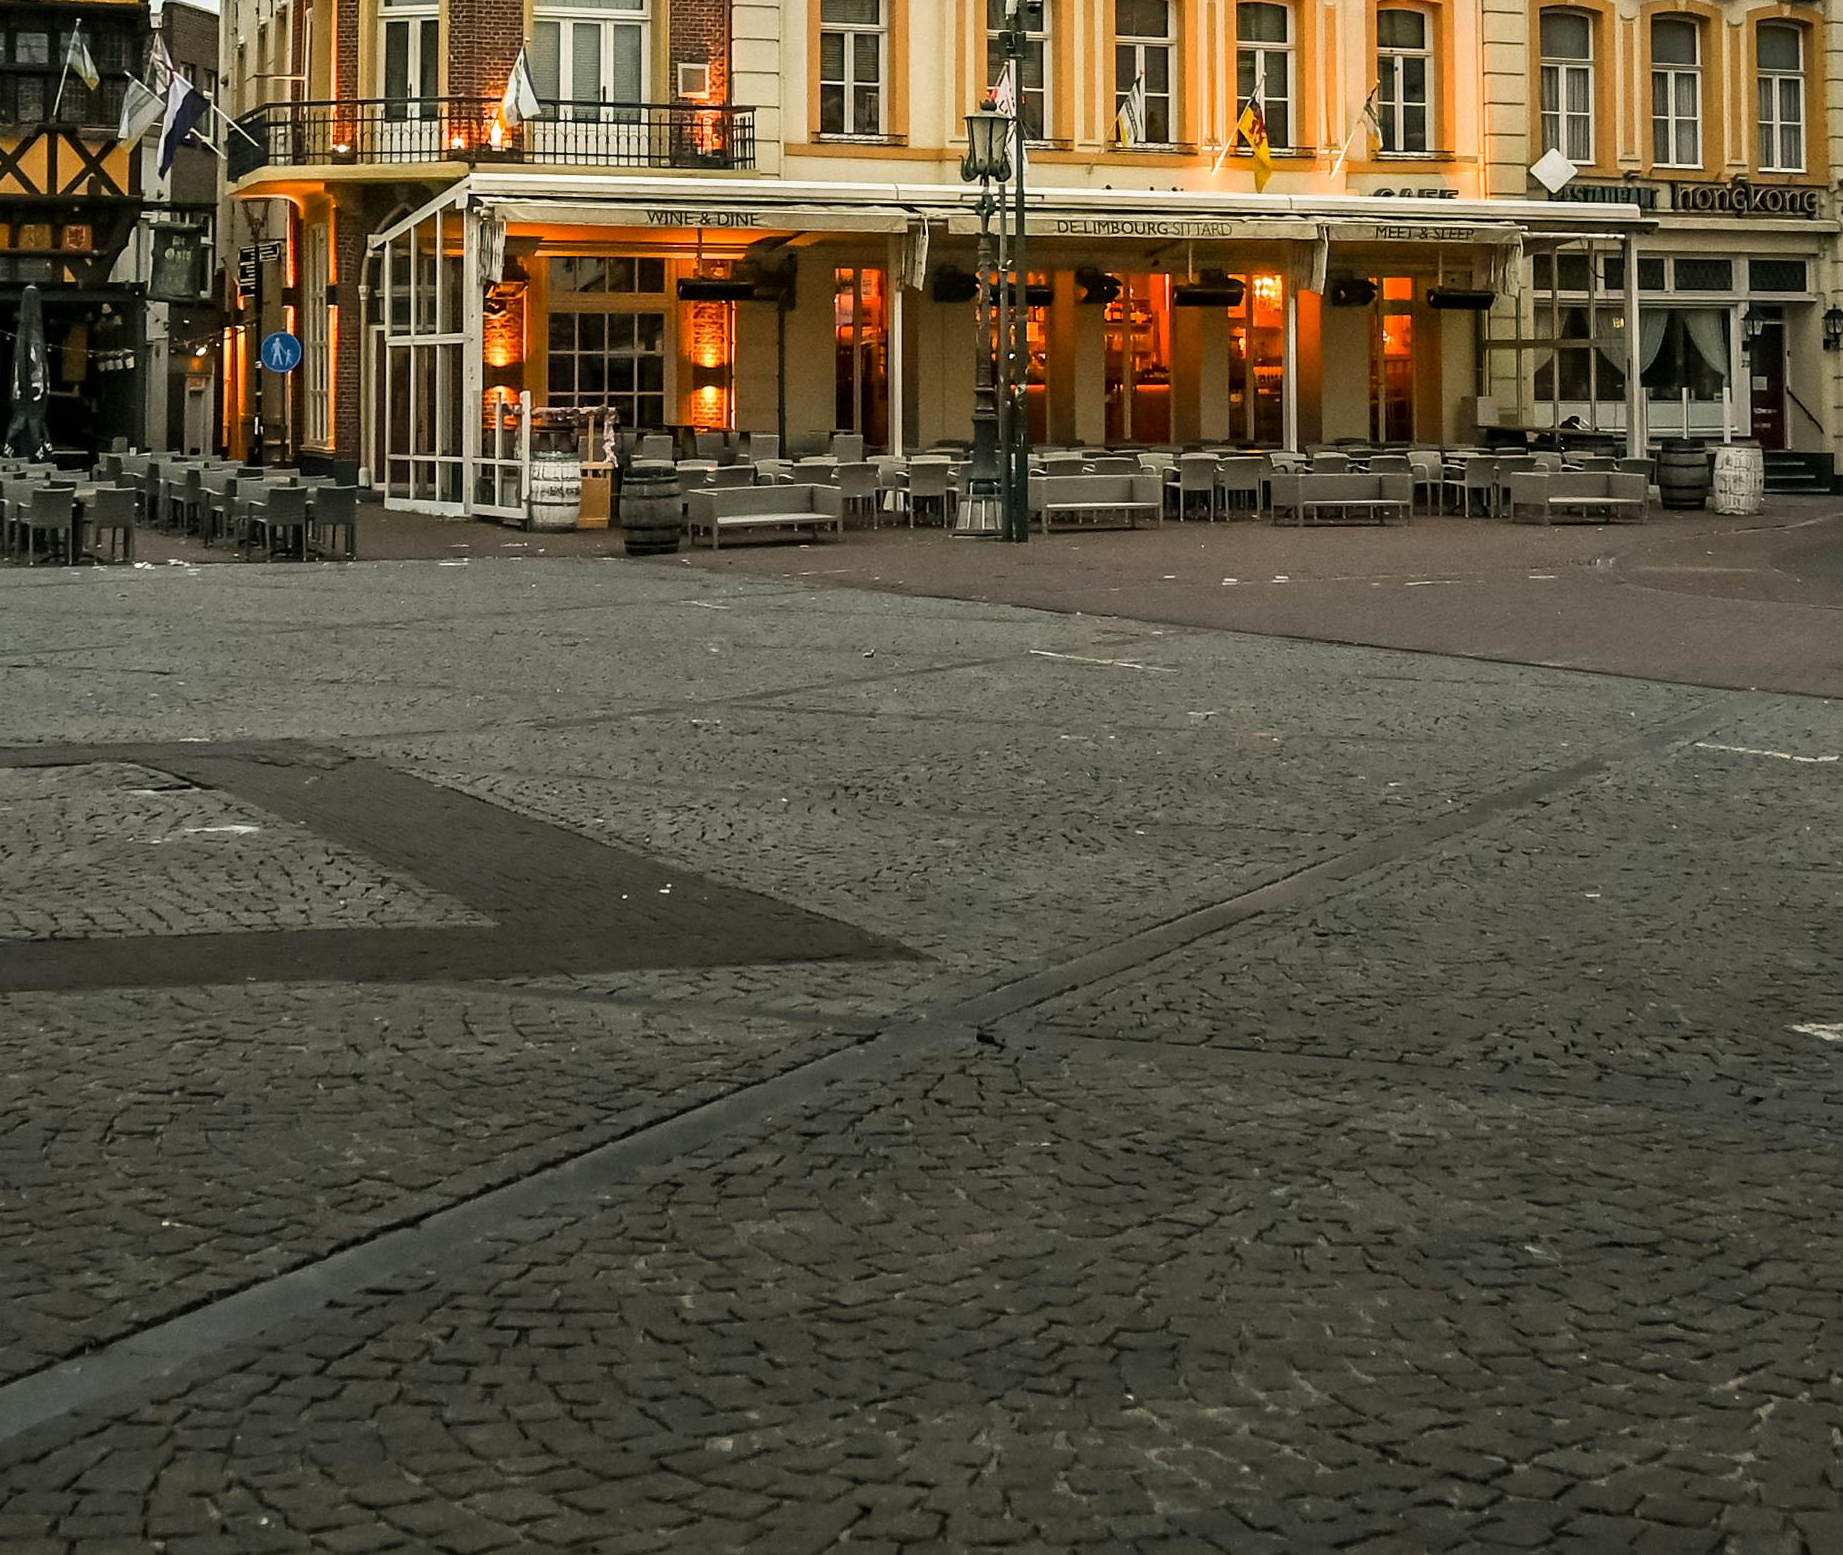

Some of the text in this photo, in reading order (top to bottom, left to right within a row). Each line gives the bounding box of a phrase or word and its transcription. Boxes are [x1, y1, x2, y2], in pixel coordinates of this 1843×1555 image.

[647, 210, 759, 226] WINE & DINE
[1057, 220, 1232, 236] DE LIMBOURG SITTARD
[1375, 226, 1474, 240] MEET & SLEEP
